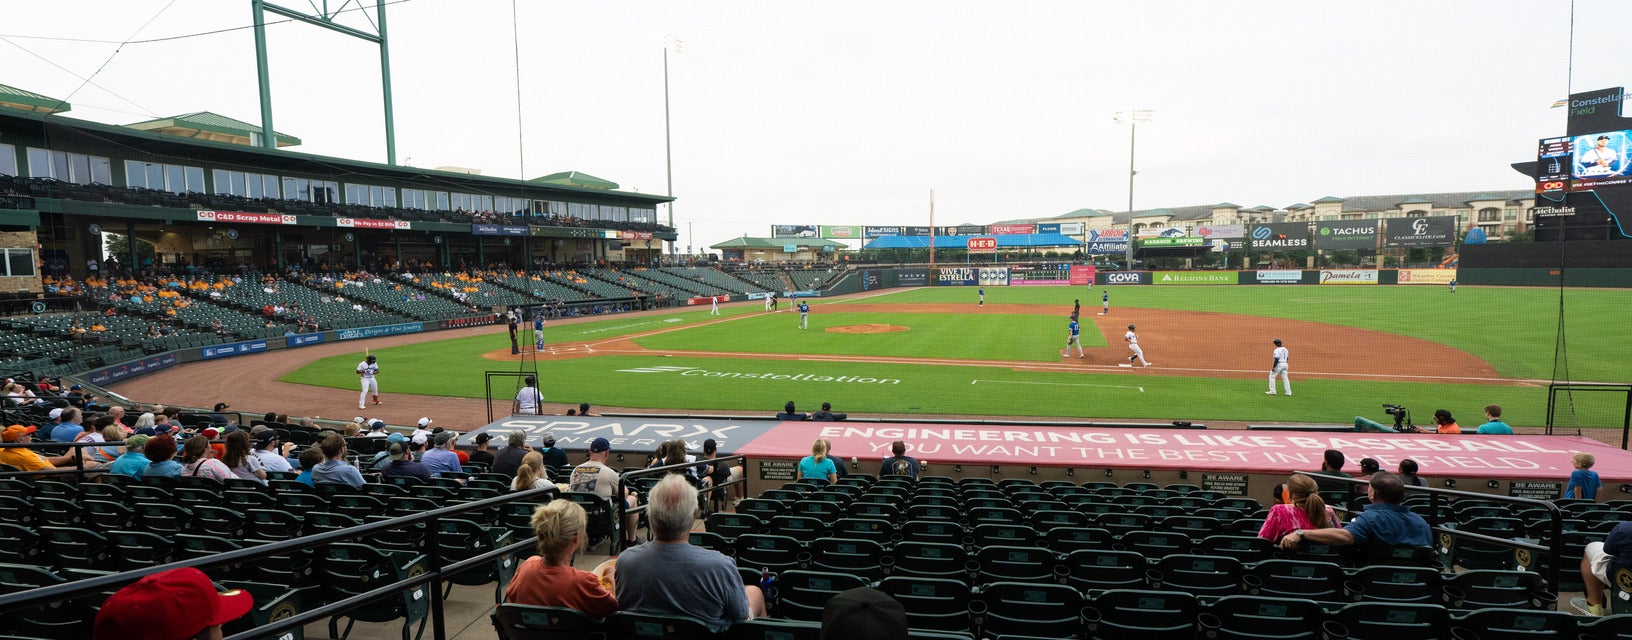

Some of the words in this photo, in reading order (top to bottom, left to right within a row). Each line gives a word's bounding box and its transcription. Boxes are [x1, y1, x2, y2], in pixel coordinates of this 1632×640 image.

[1571, 105, 1596, 116] Field
[1534, 206, 1576, 215] Methodist
[236, 214, 258, 223] Scrap
[1332, 226, 1375, 236] TACHUS
[1252, 238, 1308, 248] SEAMLESS
[940, 267, 958, 275] VIVE
[960, 267, 970, 275] TU
[1108, 273, 1140, 282] GOYA
[1320, 271, 1361, 284] Pamela
[680, 369, 902, 385] Constellation
[487, 420, 742, 439] SPARX
[468, 434, 727, 448] ENGNEERG
[819, 426, 1117, 445] ENGINEERING
[1123, 433, 1168, 446] IS
[1173, 434, 1288, 448] LIKE
[868, 441, 942, 455] YOU
[952, 443, 1064, 457] WANT
[1071, 447, 1150, 460] THE
[1157, 449, 1250, 463] BEST
[1264, 451, 1312, 464] IN
[1312, 453, 1401, 467] HE
